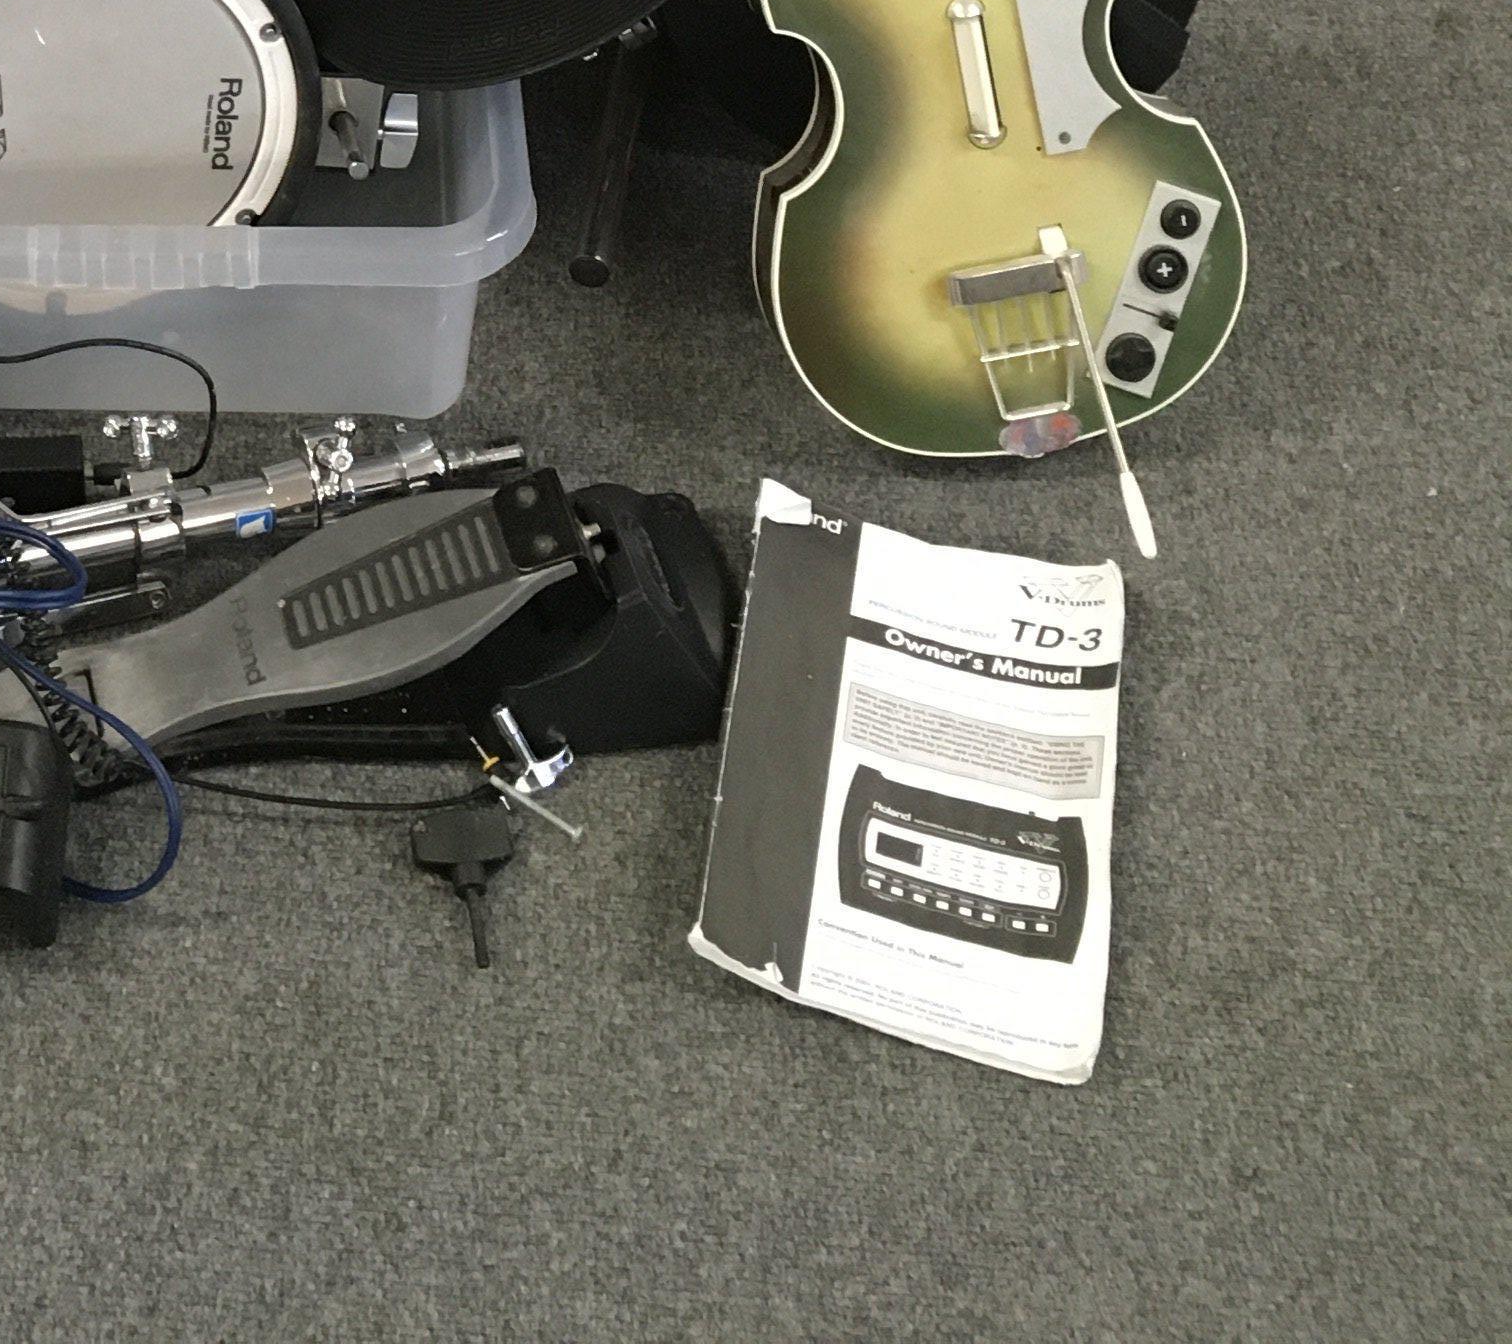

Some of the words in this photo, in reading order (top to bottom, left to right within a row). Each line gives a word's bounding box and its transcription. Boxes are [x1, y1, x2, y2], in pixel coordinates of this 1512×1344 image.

[210, 78, 244, 170] Roland
[884, 627, 985, 672] Owner's
[990, 657, 1083, 685] Manual
[1010, 618, 1103, 652] TD-3
[872, 801, 912, 822] Roland
